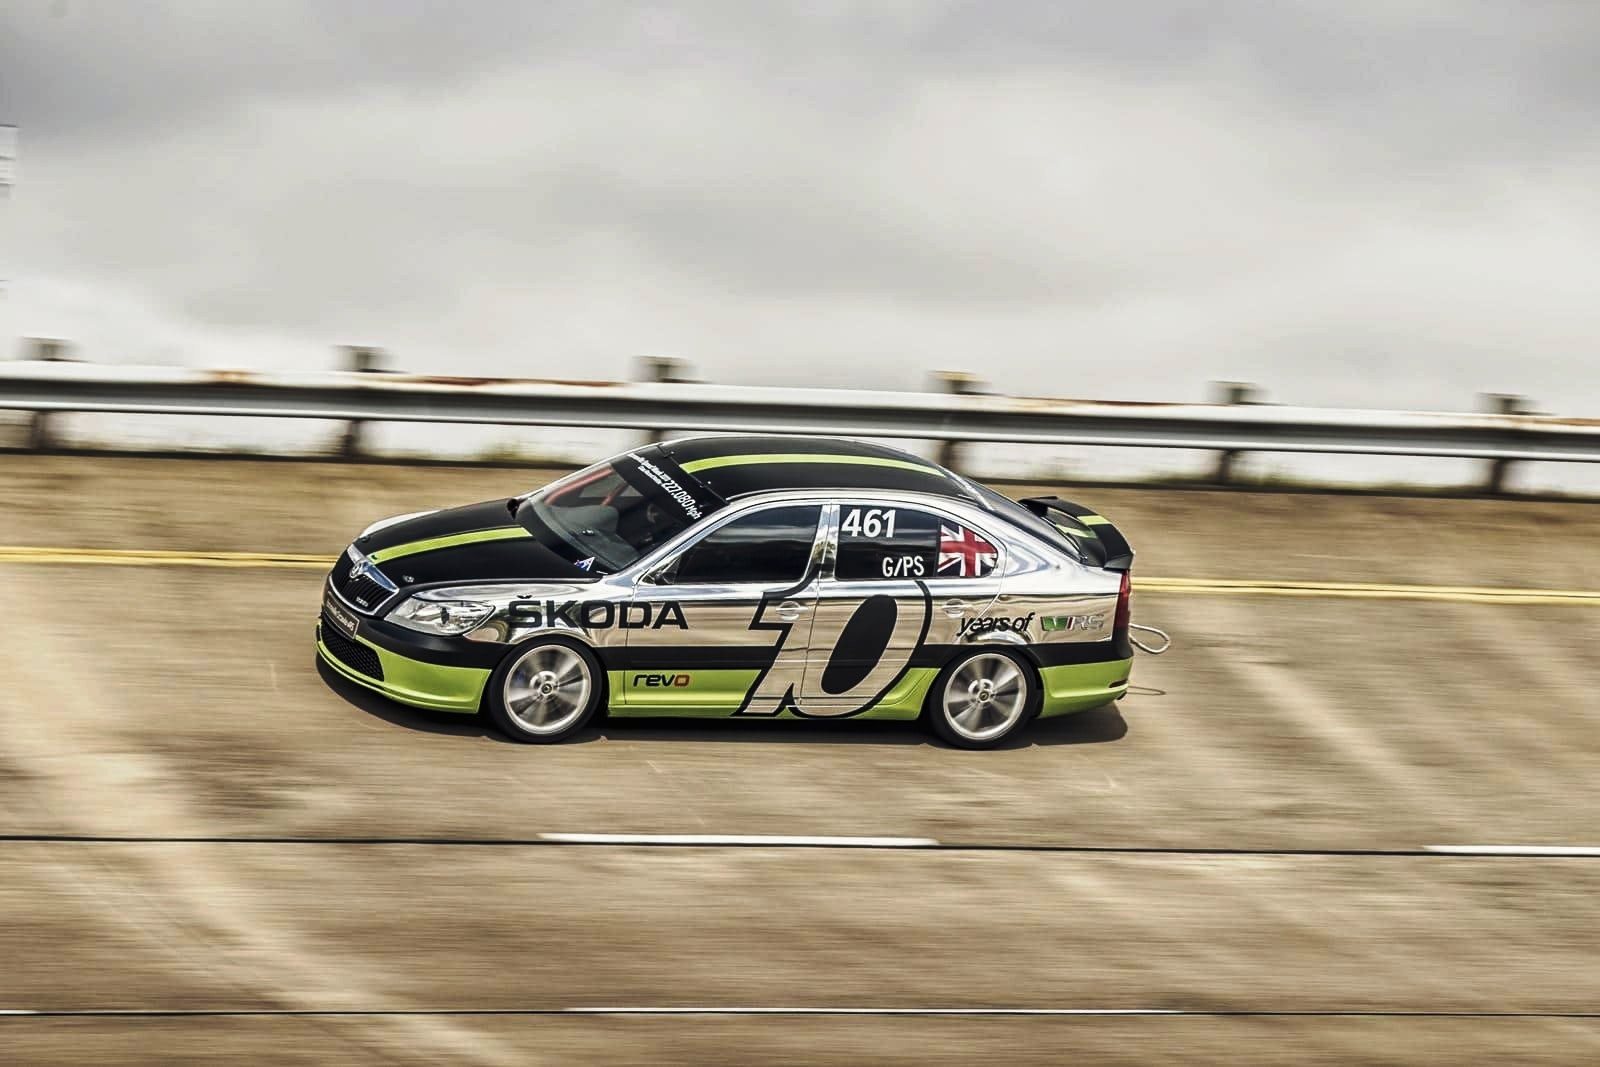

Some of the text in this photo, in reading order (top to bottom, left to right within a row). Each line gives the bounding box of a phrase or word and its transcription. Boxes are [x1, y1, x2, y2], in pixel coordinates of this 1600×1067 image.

[661, 480, 696, 507] 227.080
[841, 509, 896, 538] 461
[882, 556, 924, 577] G/PS
[508, 595, 689, 630] ŠKODA
[957, 616, 1007, 637] years
[1011, 612, 1035, 632] of
[633, 674, 690, 688] revo
